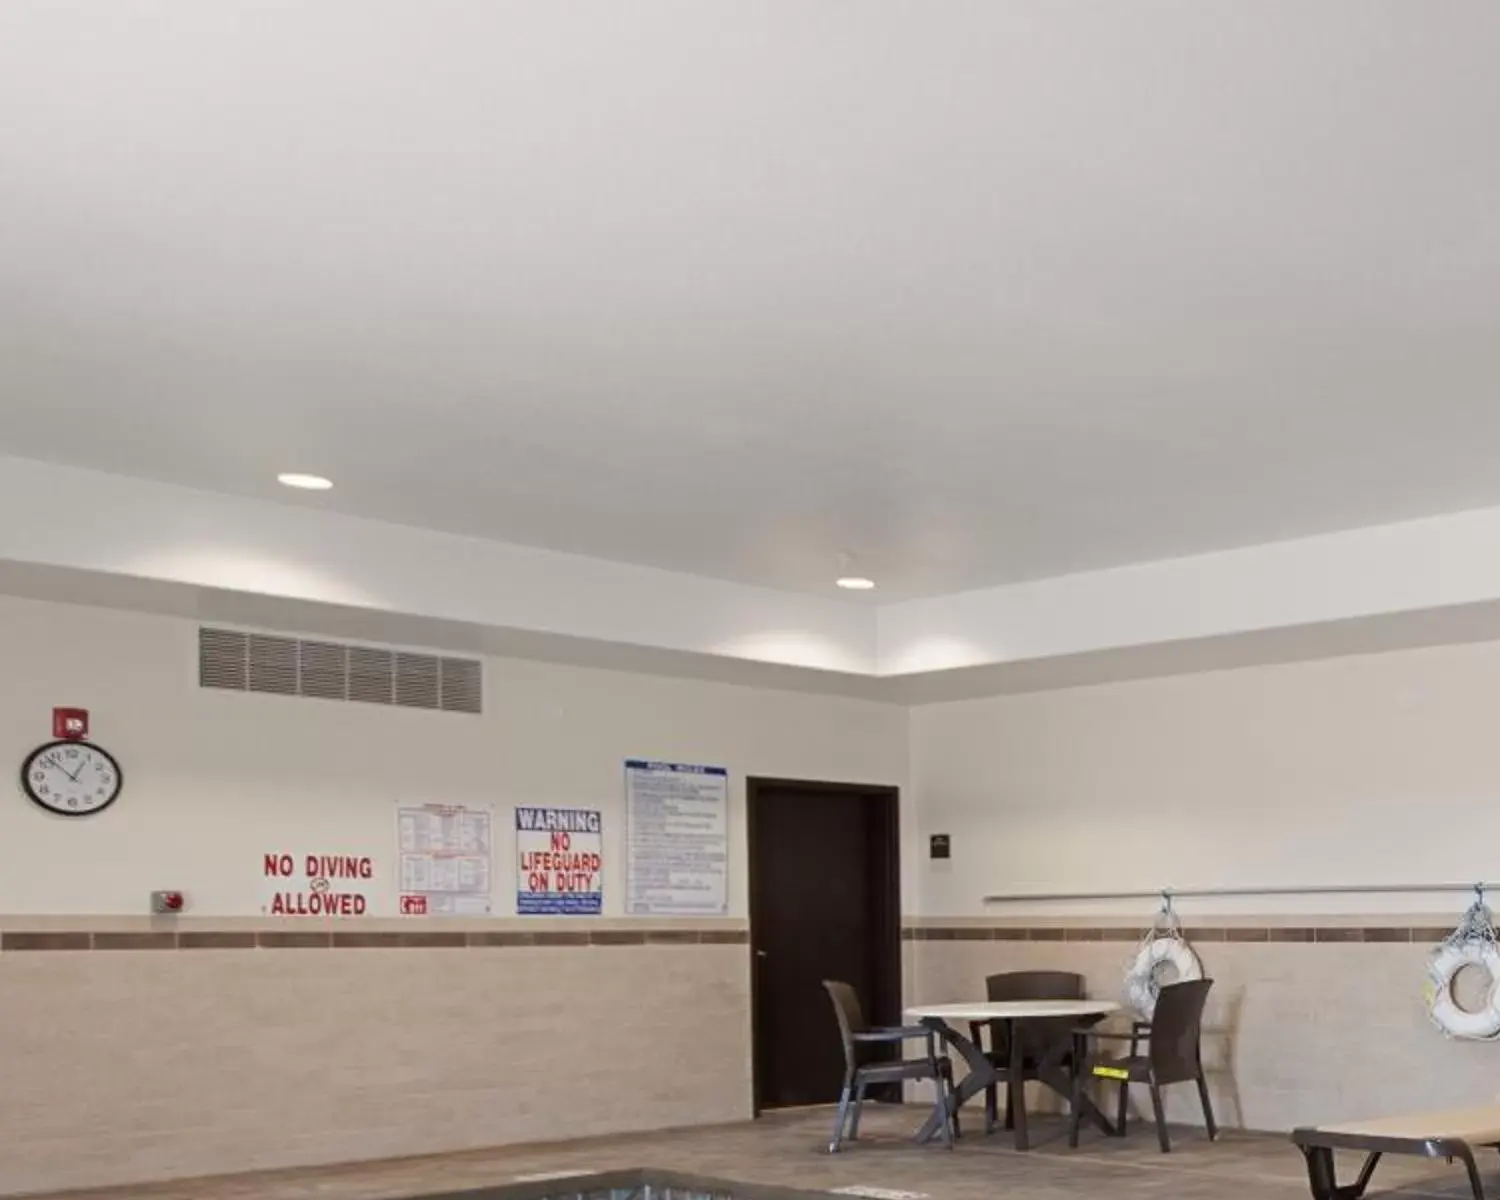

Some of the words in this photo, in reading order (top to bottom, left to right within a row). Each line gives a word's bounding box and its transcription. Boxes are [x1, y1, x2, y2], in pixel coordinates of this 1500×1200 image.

[519, 809, 599, 832] WARNING
[551, 832, 570, 851] NO
[264, 854, 293, 877] NO
[306, 855, 372, 879] DIVING
[521, 852, 600, 872] LIFEGUARD
[528, 872, 549, 893] ON
[556, 873, 593, 892] DUTY
[271, 892, 366, 915] ALLOWED
